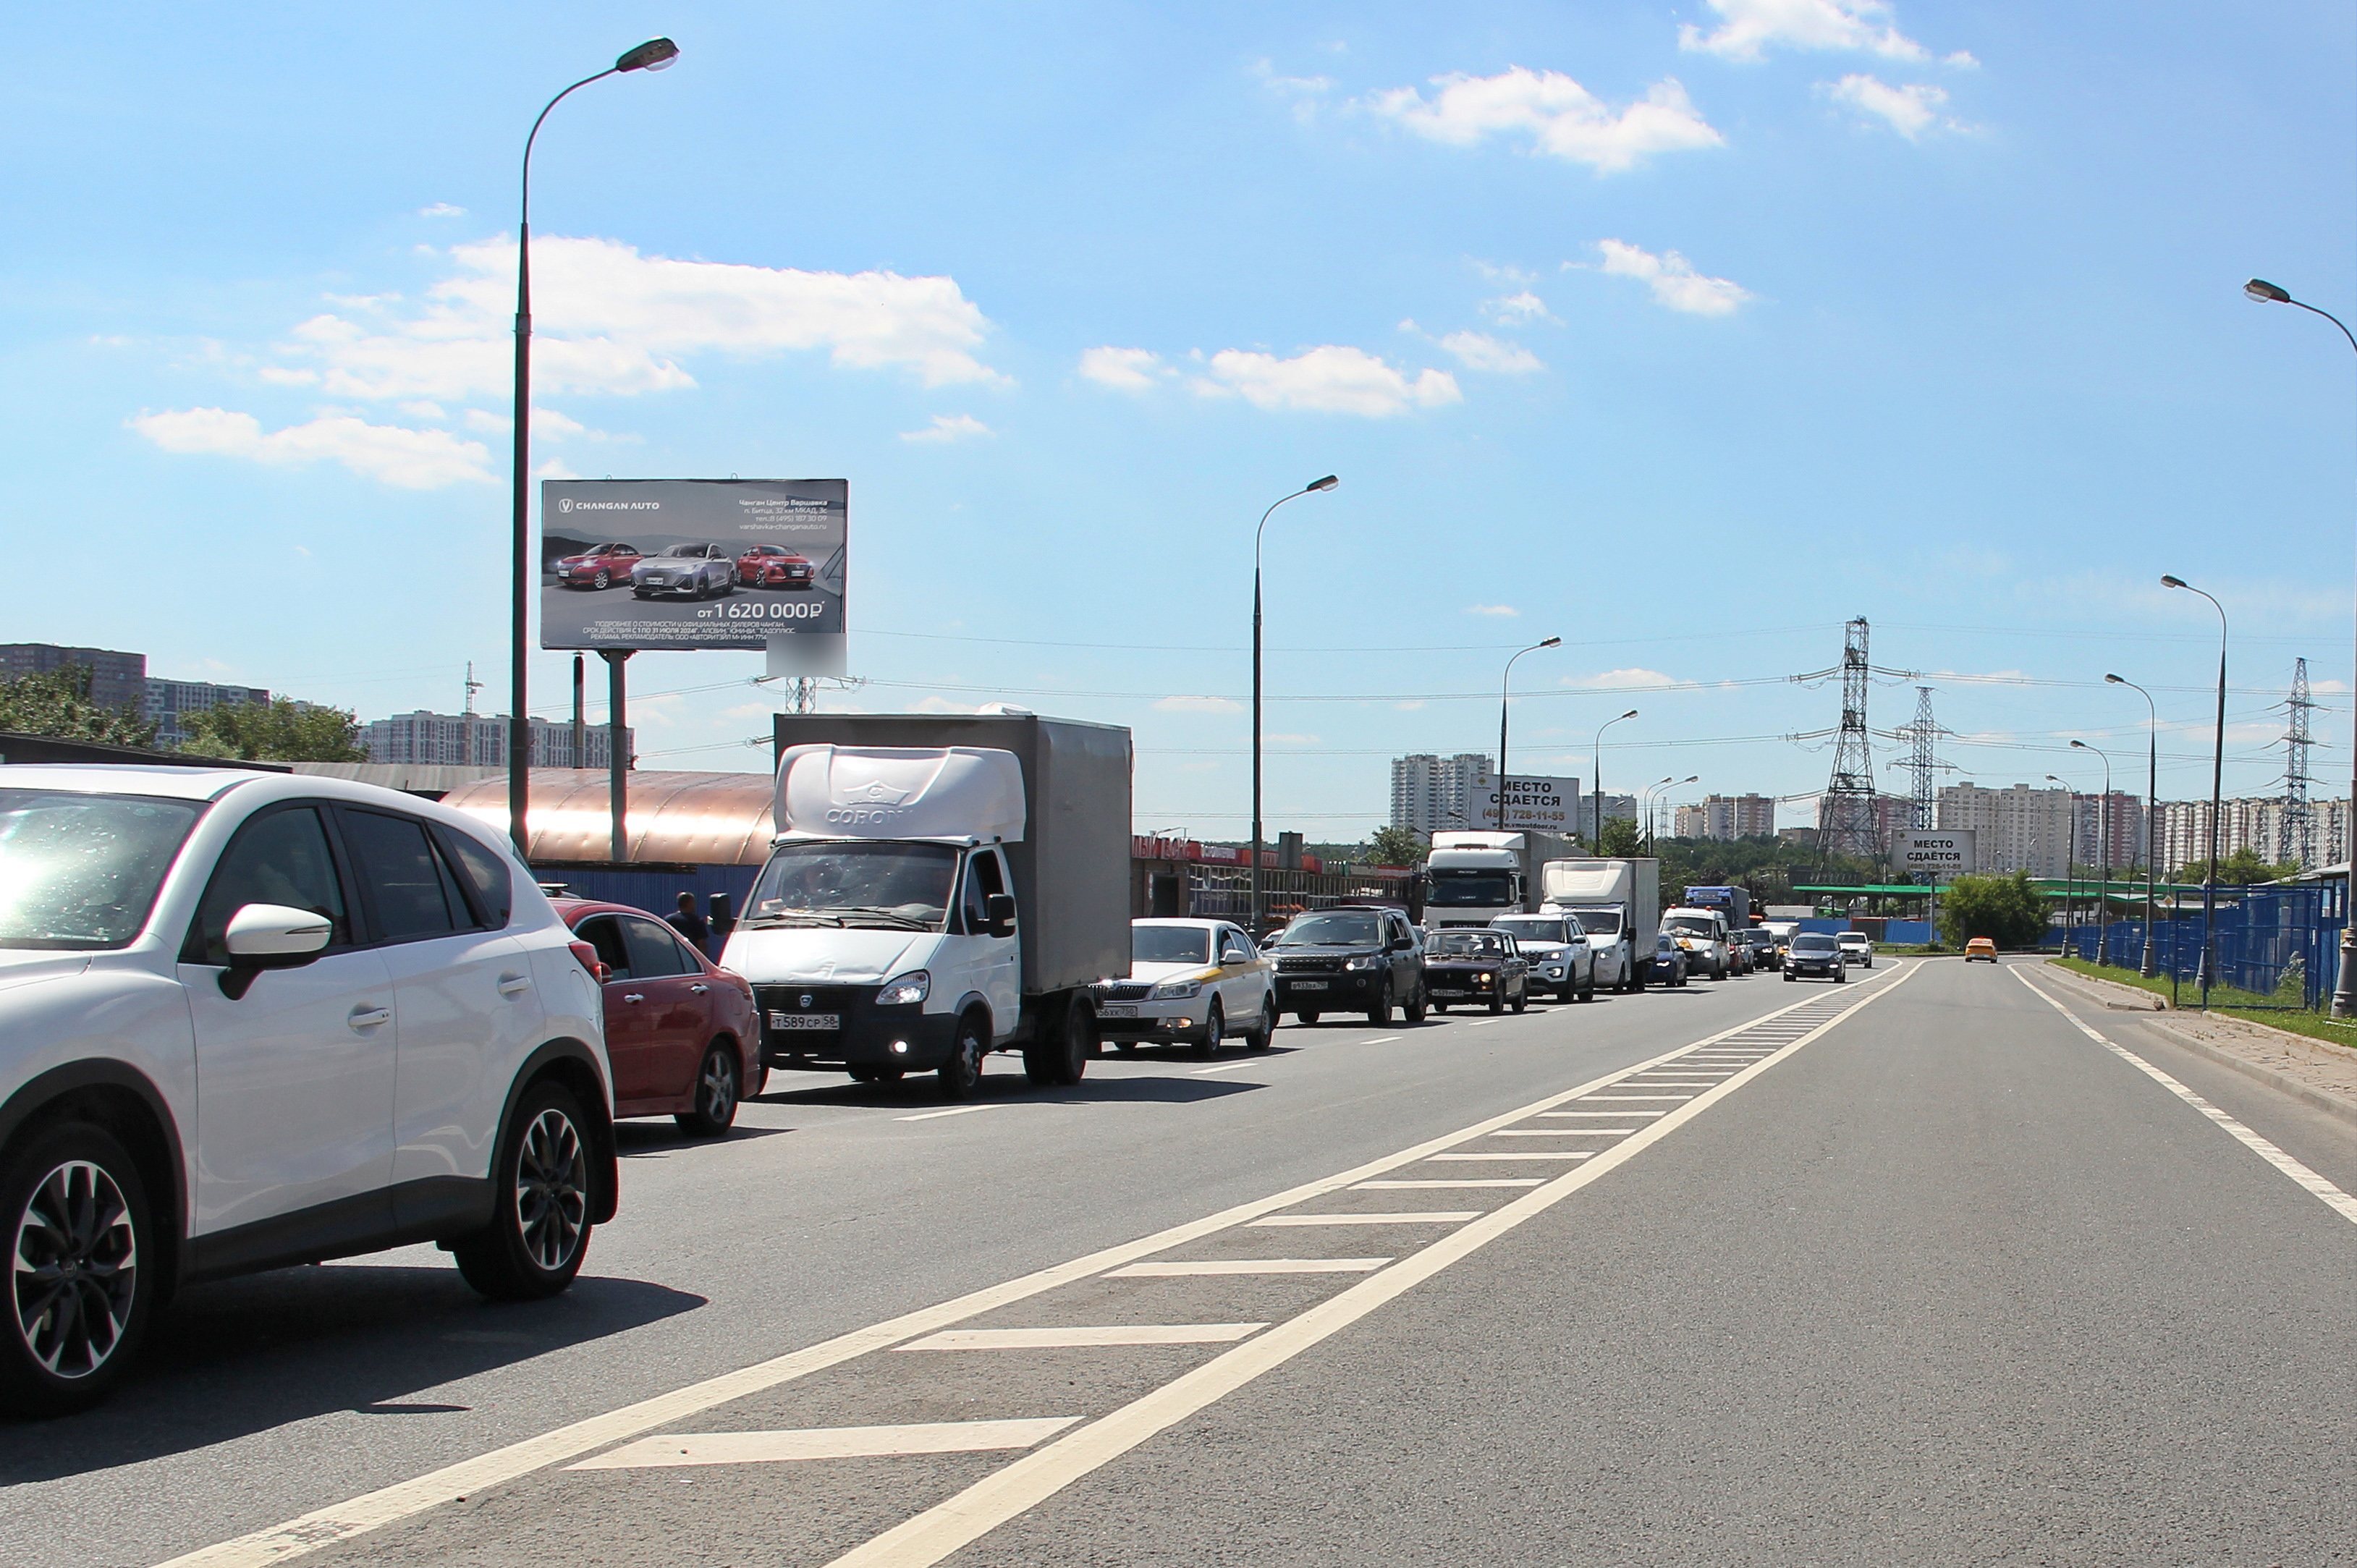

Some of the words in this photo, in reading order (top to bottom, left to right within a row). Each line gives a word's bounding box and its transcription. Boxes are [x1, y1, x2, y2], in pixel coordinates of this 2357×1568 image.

[714, 603, 722, 618] 1
[728, 603, 764, 619] 620
[1483, 808, 1510, 821] (49)
[1512, 810, 1565, 821] 728-11-55
[1914, 840, 1954, 849] МЕСТО
